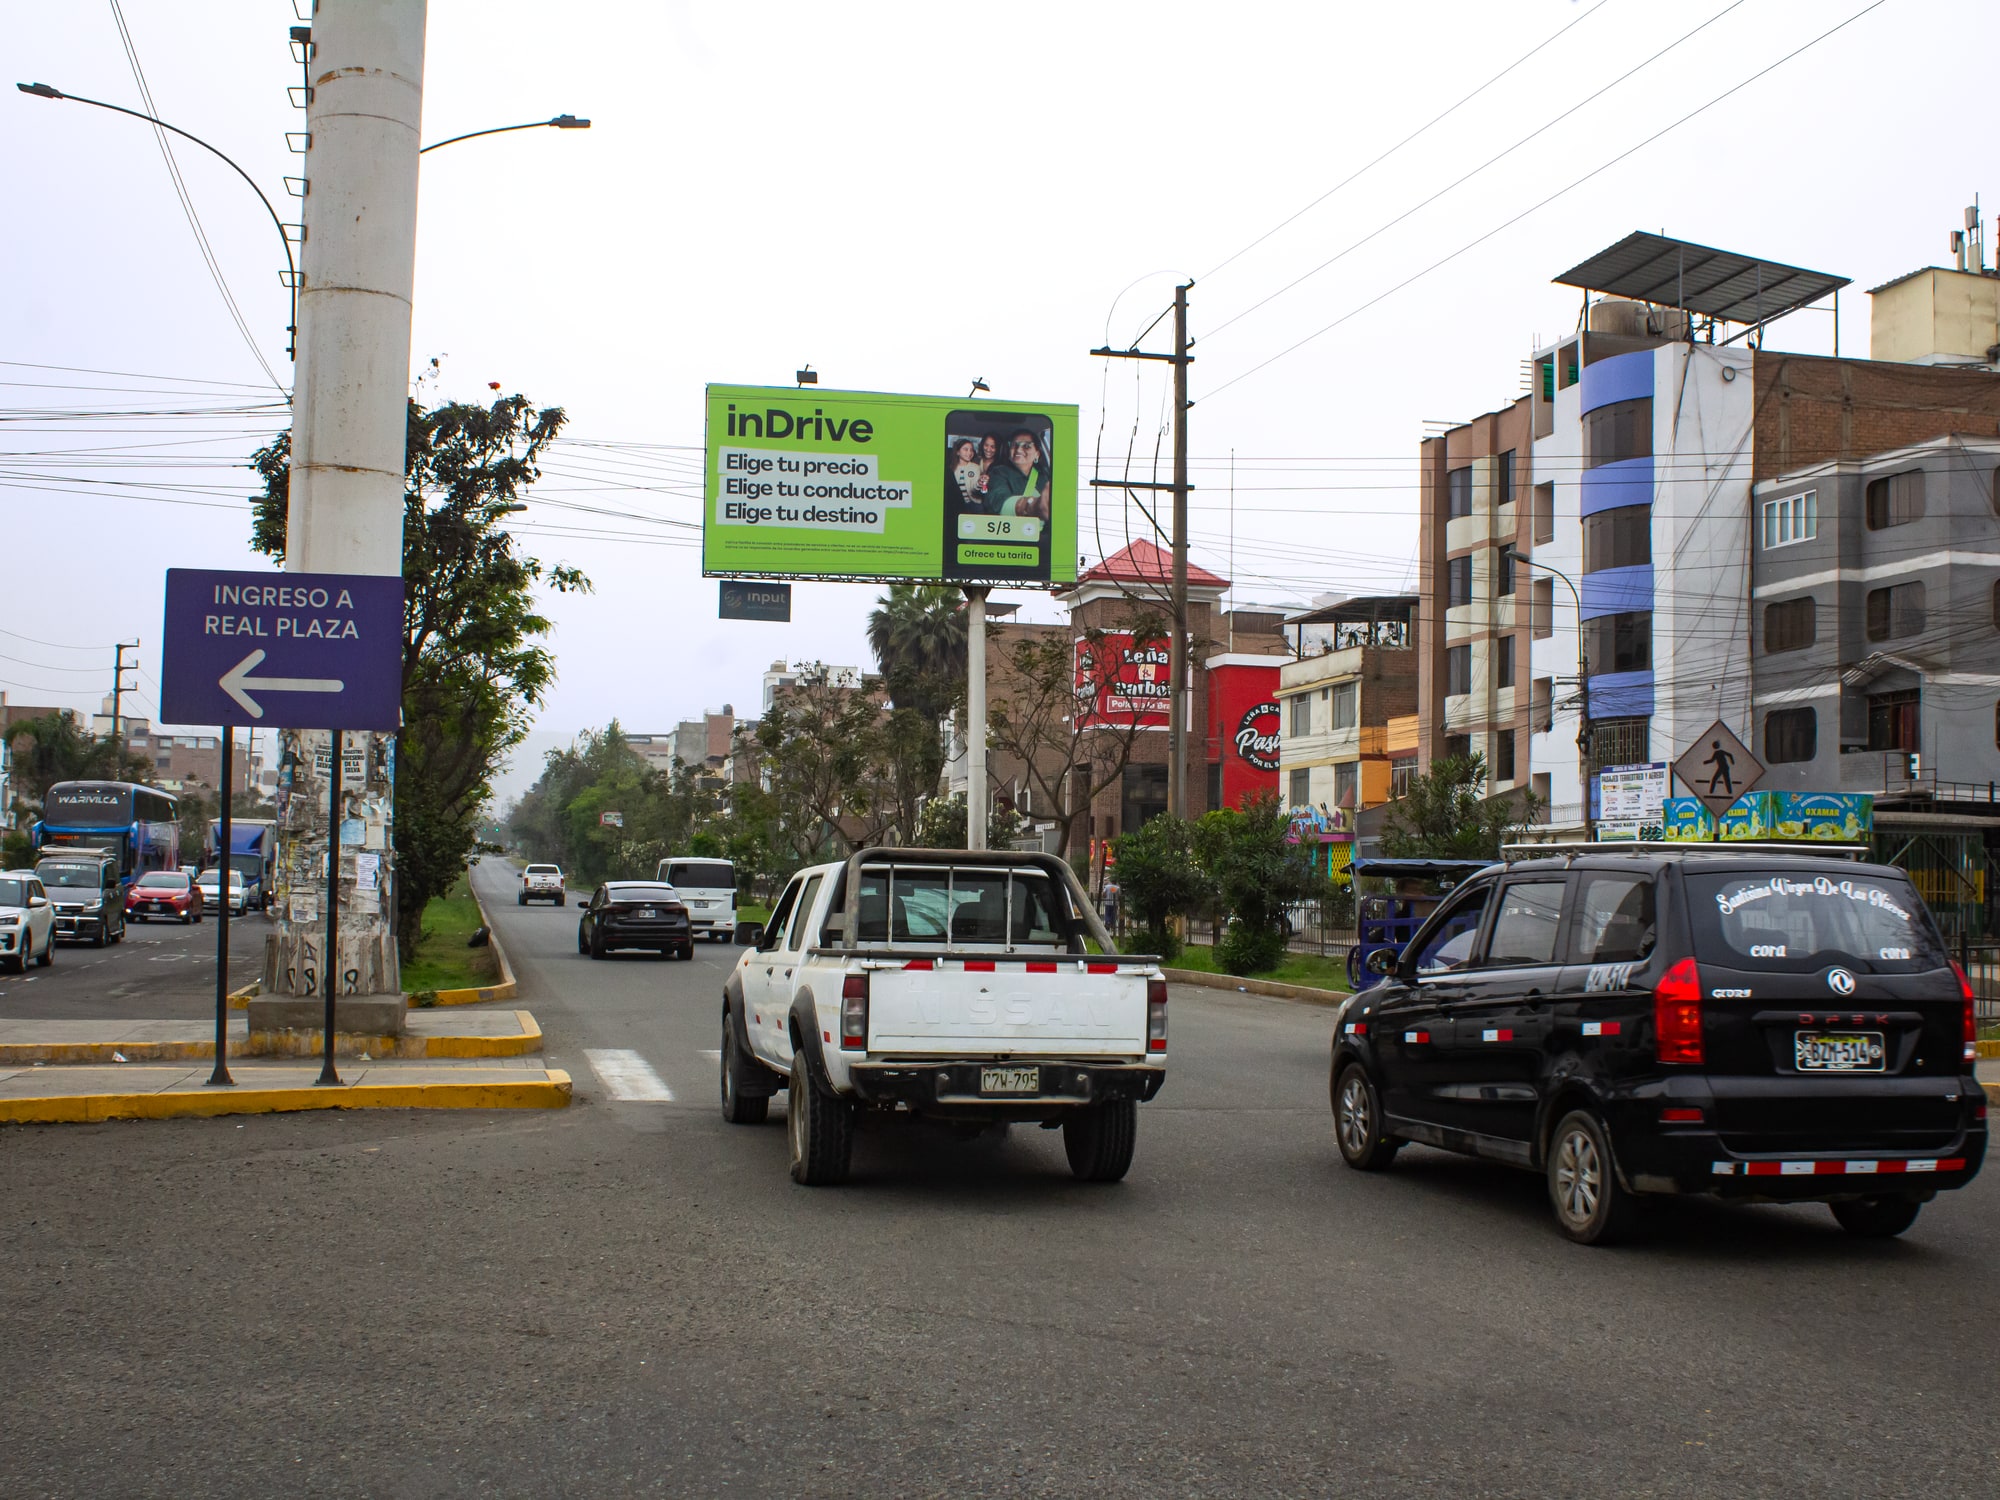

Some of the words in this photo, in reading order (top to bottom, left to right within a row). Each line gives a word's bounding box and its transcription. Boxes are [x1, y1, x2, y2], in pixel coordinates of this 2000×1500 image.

[727, 404, 873, 443] inDrive
[726, 453, 773, 475] Elige
[777, 457, 799, 473] tu
[803, 459, 868, 477] precio
[726, 478, 773, 500] Elige
[777, 481, 799, 497] tu
[803, 482, 909, 500] conductor
[725, 502, 772, 524] Elige
[776, 506, 798, 521] tu
[802, 505, 878, 524] destino
[987, 521, 1011, 535] S/8
[964, 550, 994, 558] Ofrece
[996, 551, 1006, 559] tu
[214, 584, 328, 608] INGRESO
[335, 589, 354, 609] A
[205, 615, 268, 637] REAL
[276, 617, 359, 639] PLAZA
[1235, 728, 1280, 756] Pasi
[1814, 877, 1839, 895] De
[907, 990, 1112, 1027] NISSAN
[983, 1072, 1038, 1090] C7W-795
